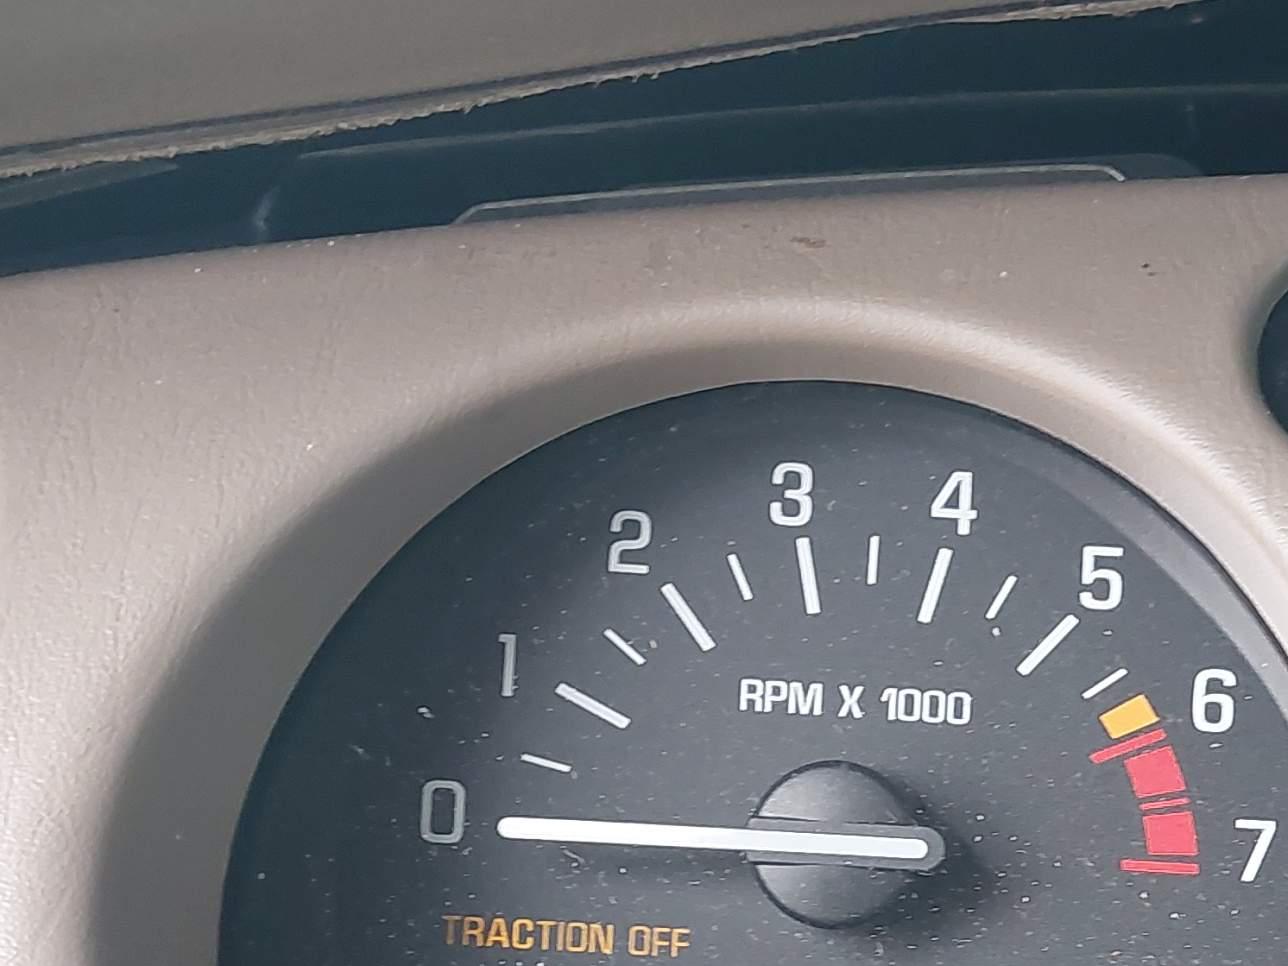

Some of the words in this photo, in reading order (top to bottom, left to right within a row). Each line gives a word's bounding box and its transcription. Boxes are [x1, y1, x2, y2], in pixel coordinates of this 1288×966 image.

[769, 461, 814, 526] 3
[930, 470, 979, 537] 4
[607, 510, 653, 575] 2
[1078, 545, 1125, 611] 5
[499, 633, 518, 697] 1
[738, 678, 823, 716] RPM
[837, 685, 865, 719] X
[880, 687, 973, 726] 1000
[1191, 667, 1237, 733] 6
[420, 779, 467, 845] 0
[1234, 818, 1278, 883] 7
[442, 915, 614, 955] TRACTION
[627, 925, 692, 958] OFF
